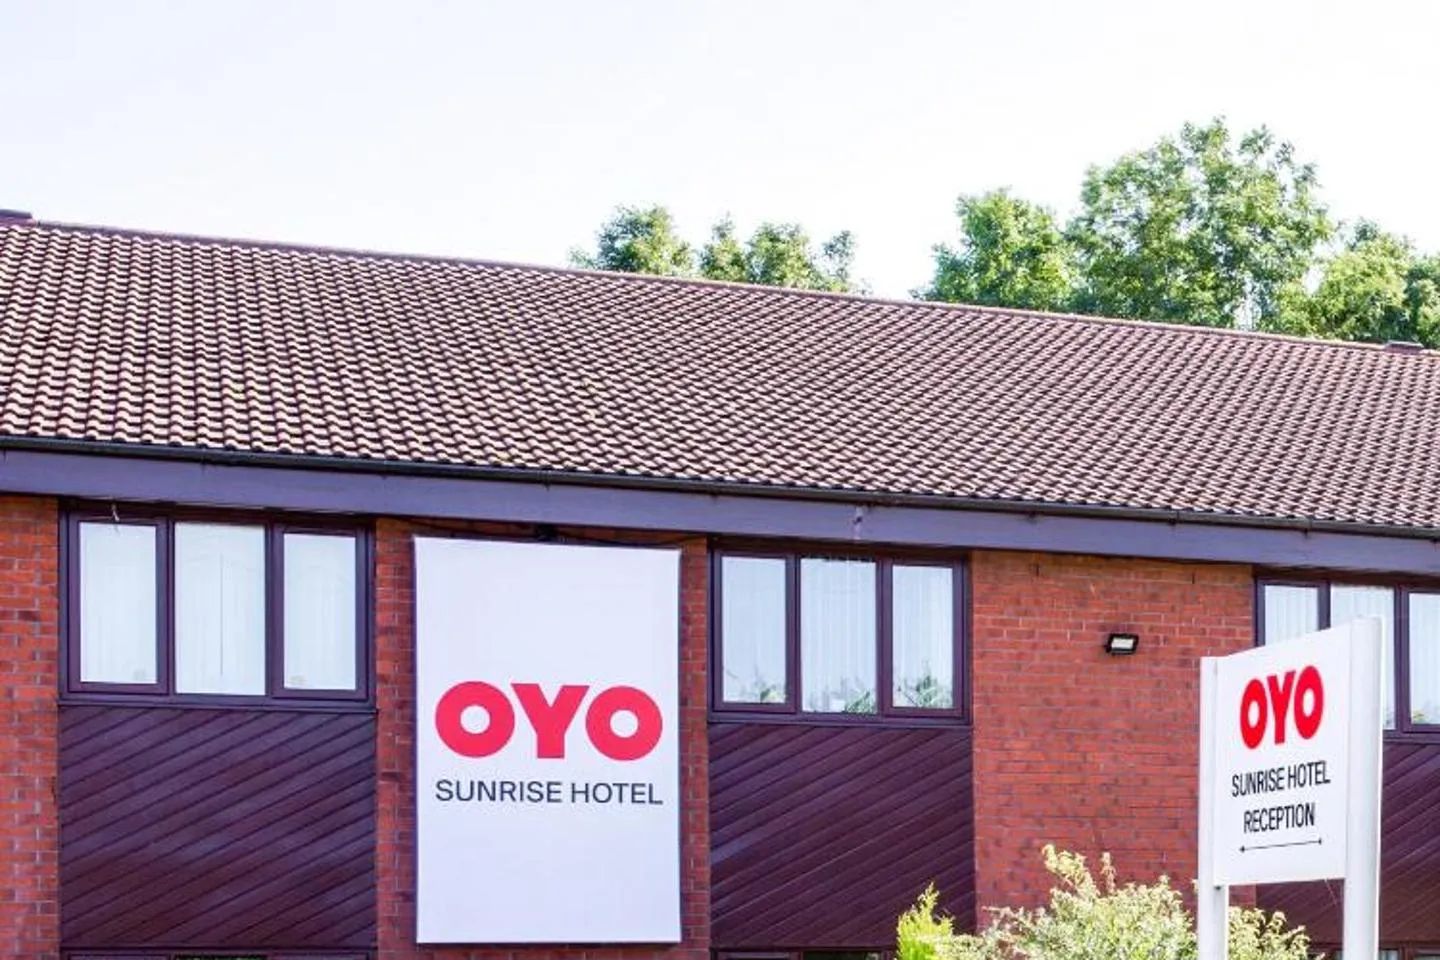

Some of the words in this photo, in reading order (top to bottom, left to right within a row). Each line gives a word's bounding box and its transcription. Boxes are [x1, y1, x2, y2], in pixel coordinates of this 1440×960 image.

[435, 681, 664, 762] OYO
[1240, 664, 1324, 750] OYO
[435, 779, 562, 804] SUNRISE
[571, 782, 664, 805] HOTEL
[1232, 766, 1284, 798] SUNRISE
[1287, 760, 1331, 791] HOTEL
[1243, 803, 1316, 834] RECEPTION
